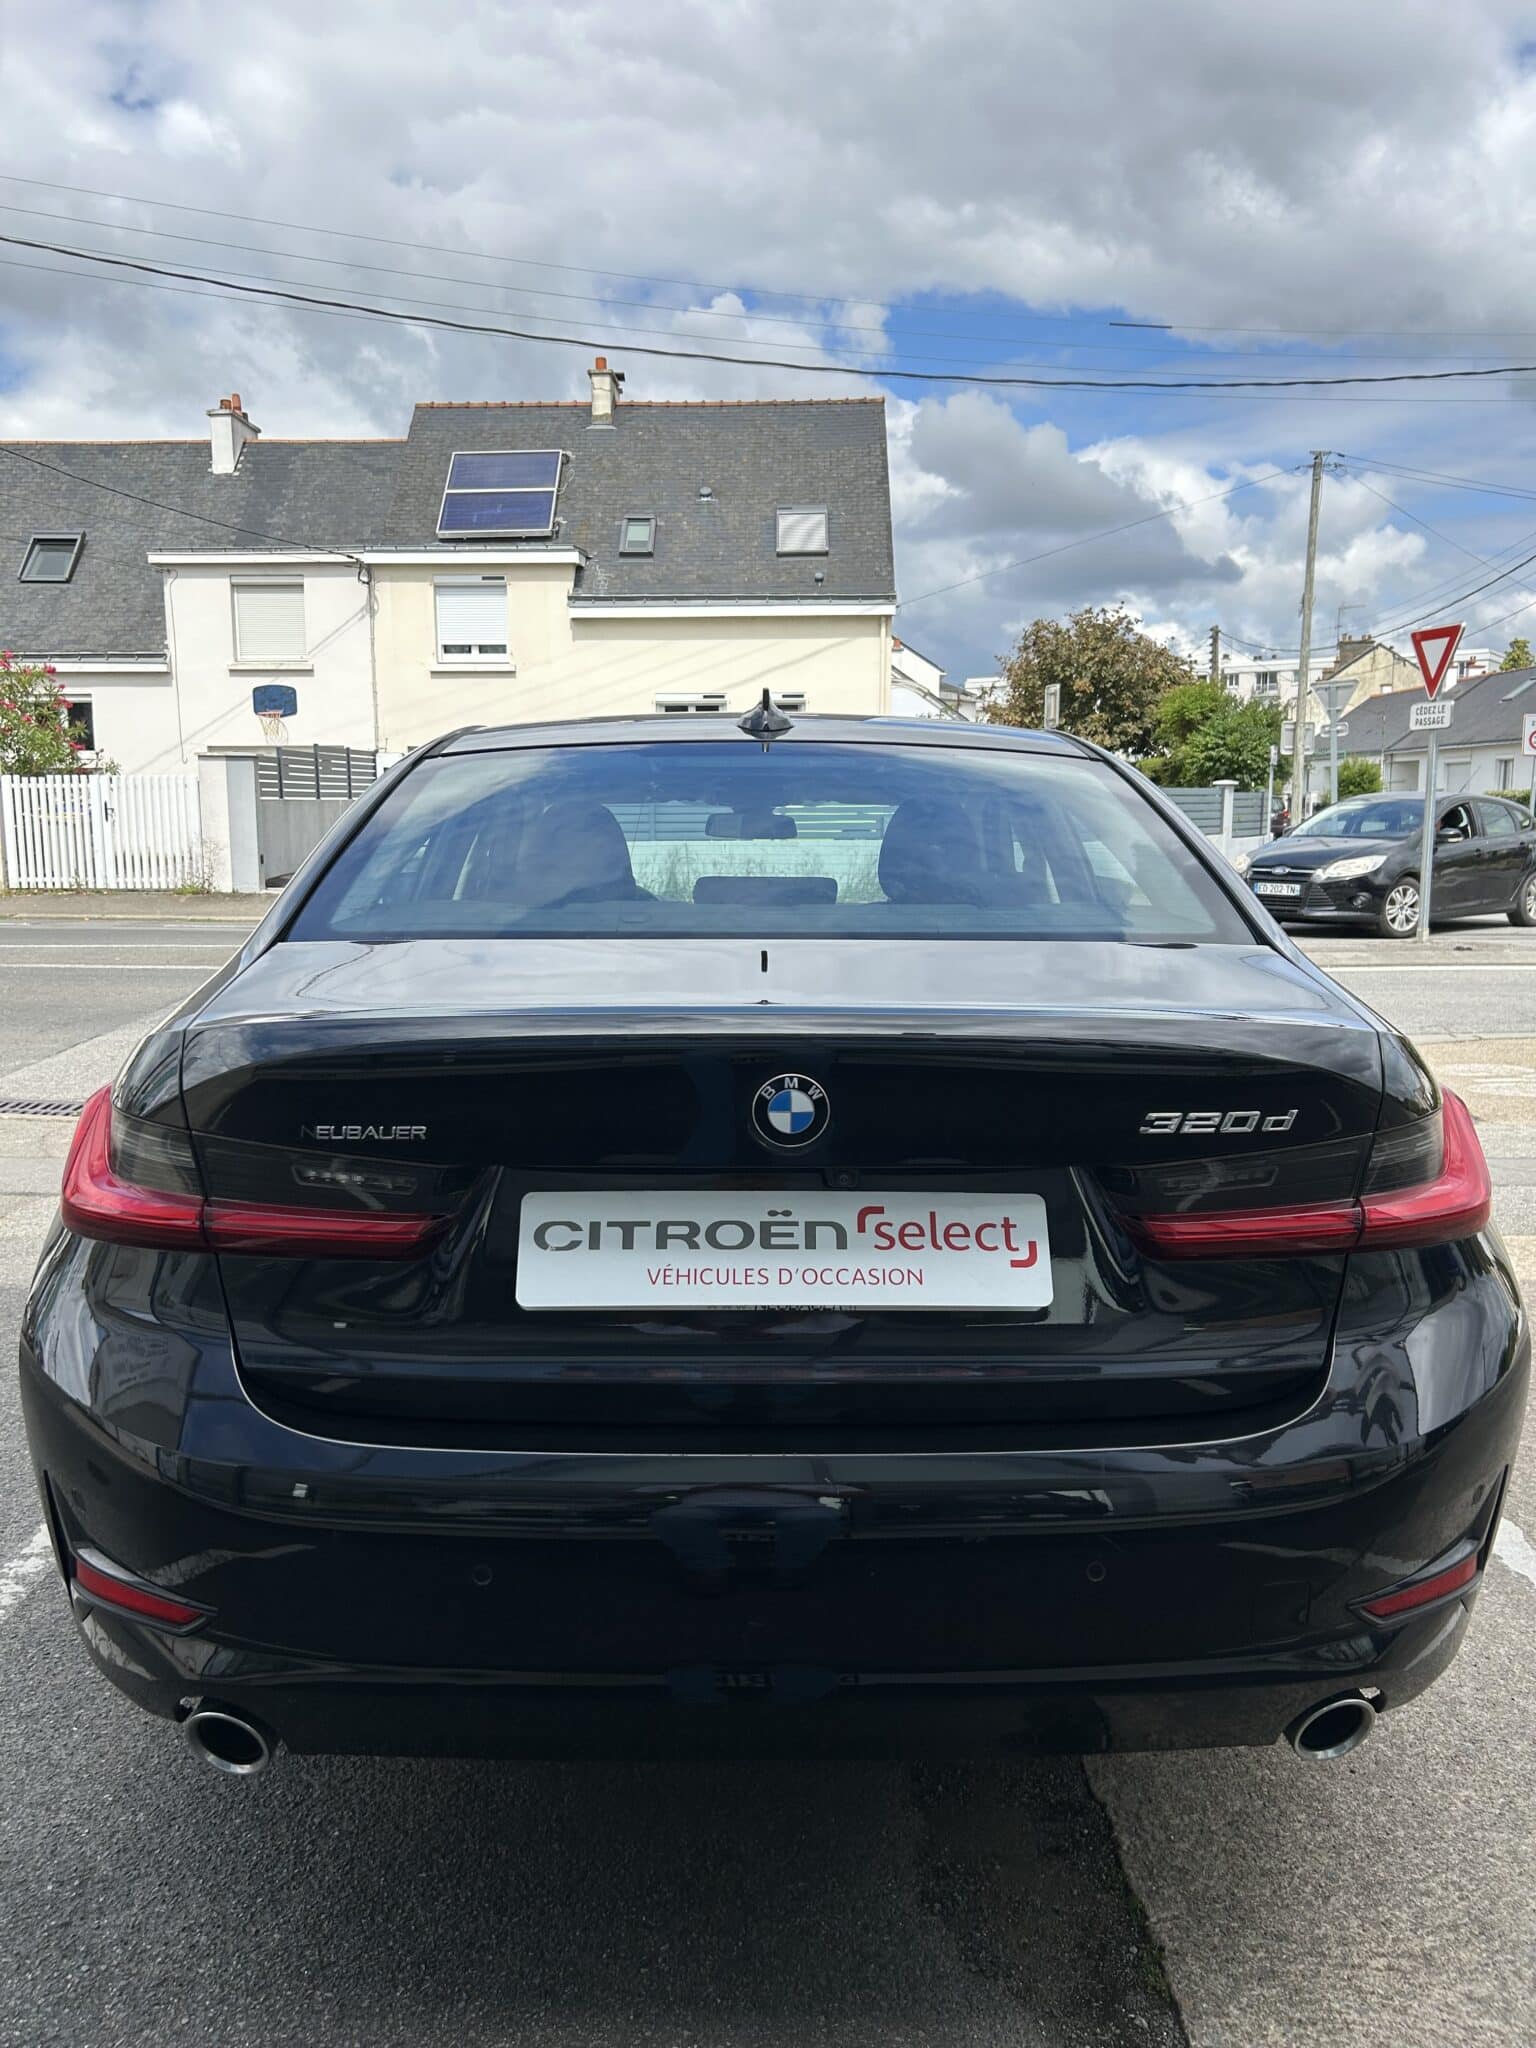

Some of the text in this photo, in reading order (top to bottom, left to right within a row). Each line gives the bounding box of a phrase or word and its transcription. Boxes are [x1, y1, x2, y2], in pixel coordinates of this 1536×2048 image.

[1415, 704, 1446, 716] CÉDEZ LE
[1415, 716, 1445, 726] PASSAGE
[760, 1077, 823, 1100] BMW
[1139, 1109, 1299, 1134] 320d
[301, 1125, 427, 1140] NEUBAUER
[873, 1211, 1020, 1252] select
[647, 1265, 923, 1286] VÉHICULES D'OCCASION
